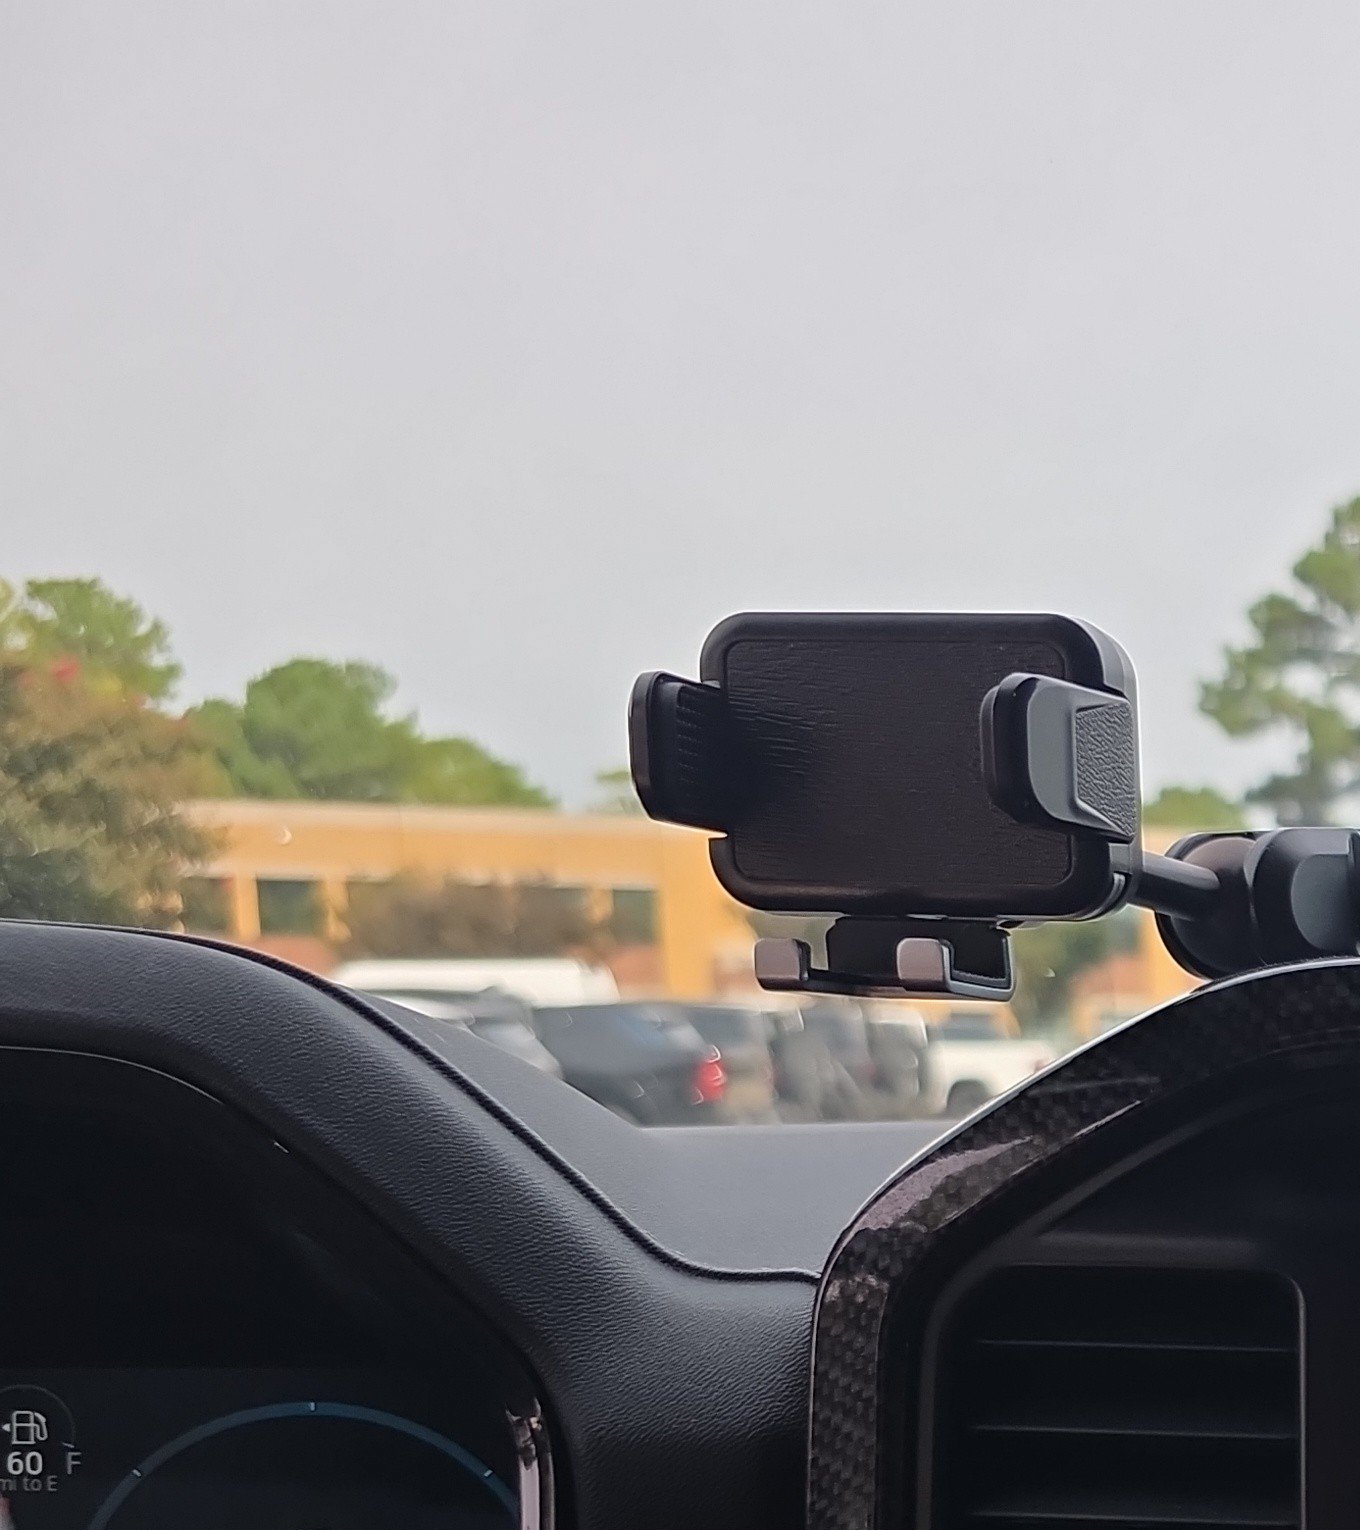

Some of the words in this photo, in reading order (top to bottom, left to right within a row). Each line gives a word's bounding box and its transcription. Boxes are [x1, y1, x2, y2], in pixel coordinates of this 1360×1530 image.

[7, 1451, 43, 1475] 60
[67, 1451, 82, 1475] F
[22, 1477, 42, 1491] to
[46, 1475, 58, 1491] E
